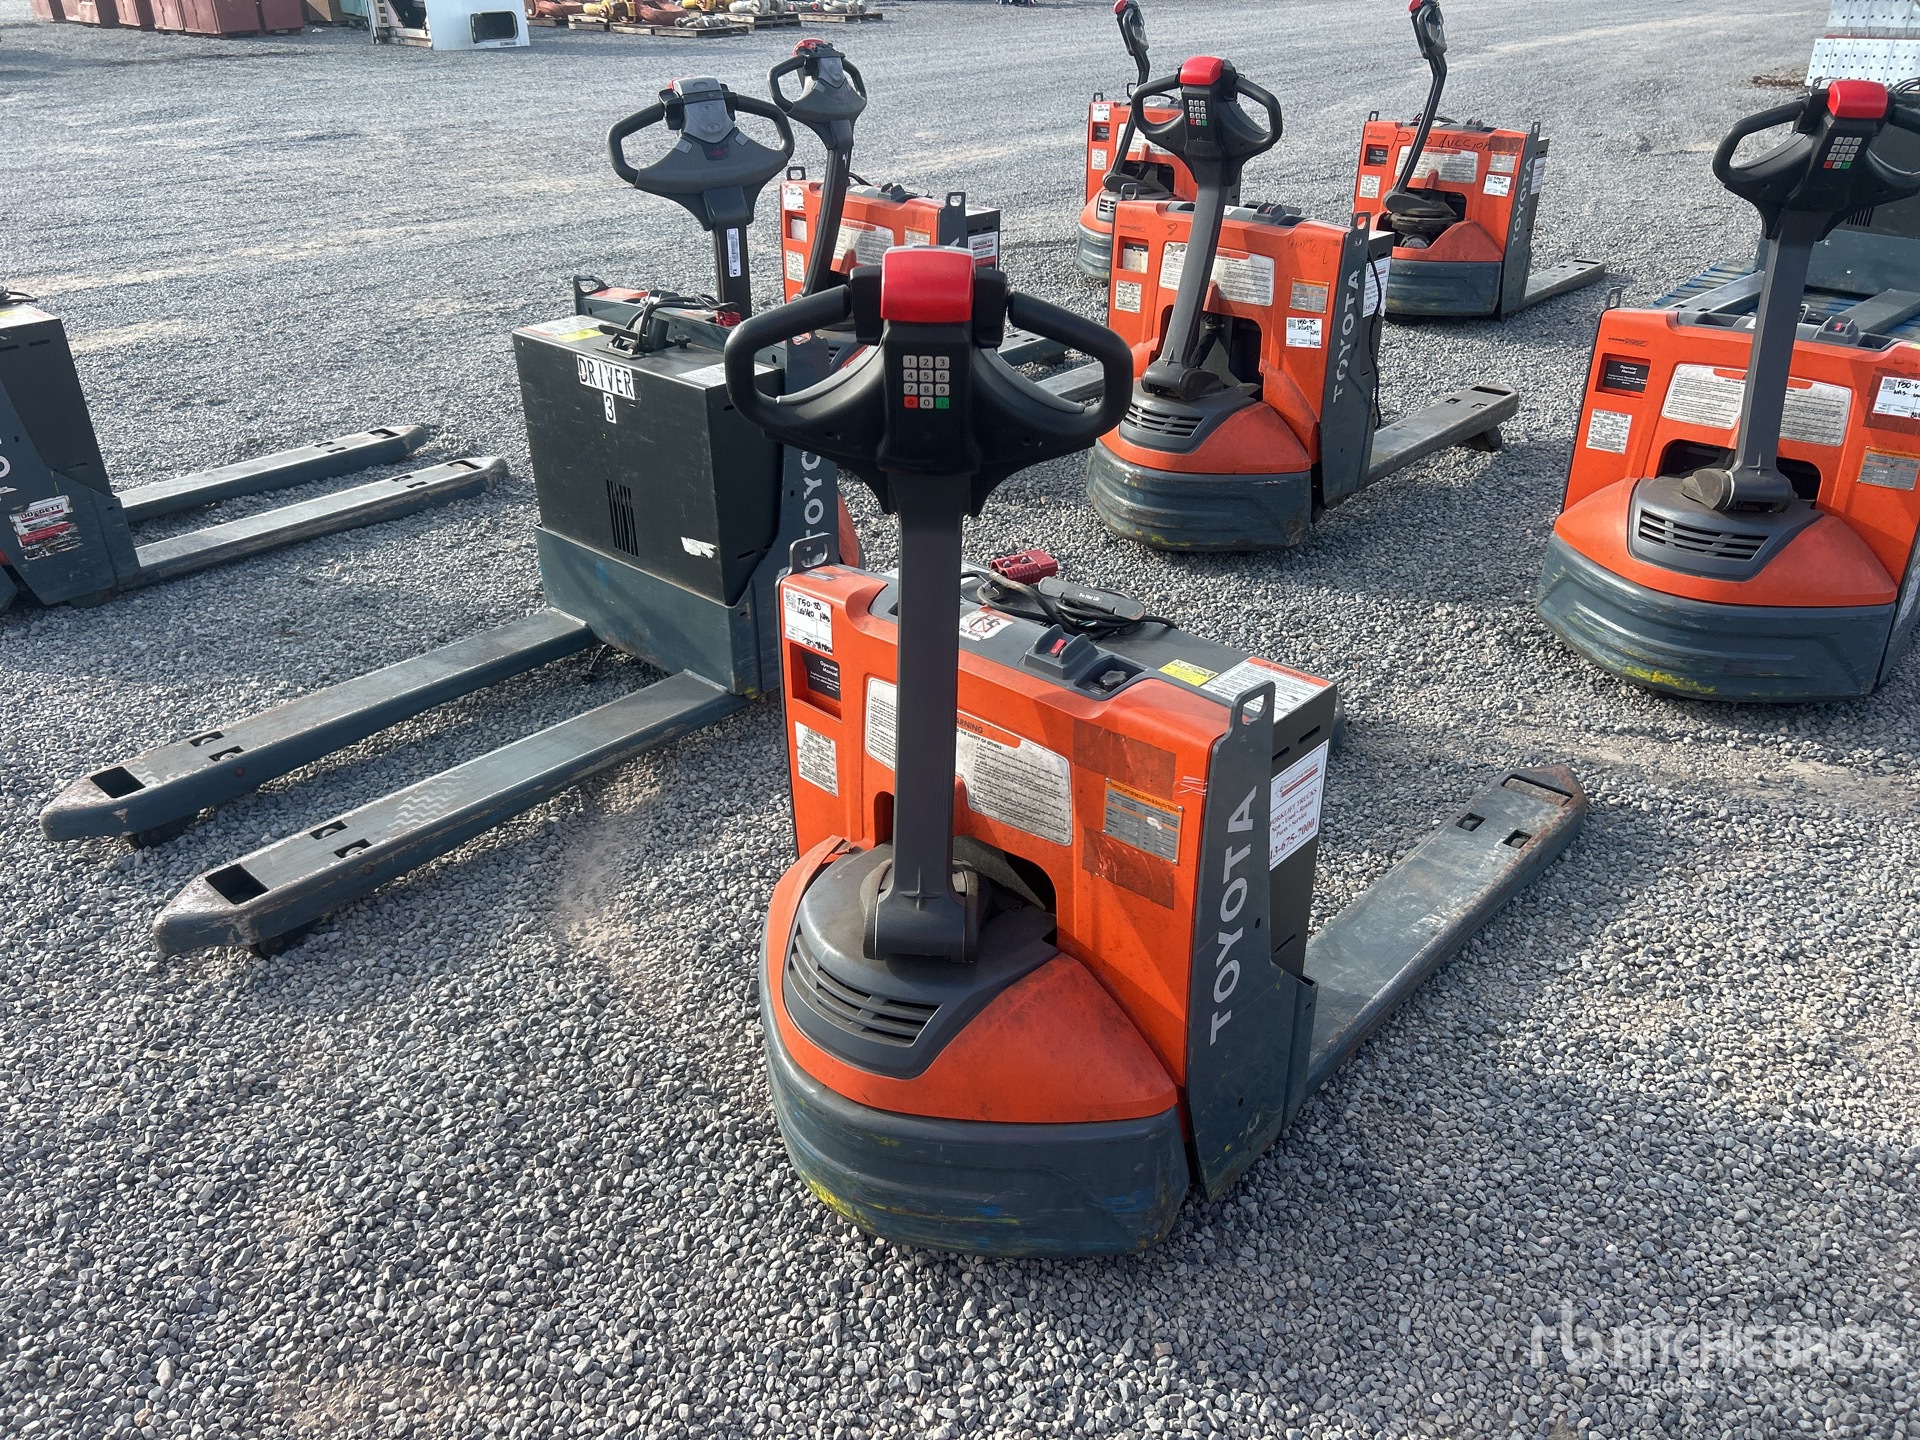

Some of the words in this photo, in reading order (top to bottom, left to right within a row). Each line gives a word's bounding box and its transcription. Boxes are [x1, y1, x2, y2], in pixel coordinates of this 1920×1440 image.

[1511, 156, 1533, 247] TOYOTA
[1333, 268, 1361, 403] TOYOTA
[578, 357, 634, 398] DRIVER
[606, 395, 614, 421] 3
[957, 717, 984, 734] ARNING
[1270, 817, 1315, 860] 13-675-7000
[1210, 786, 1257, 1047] TOYOTA
